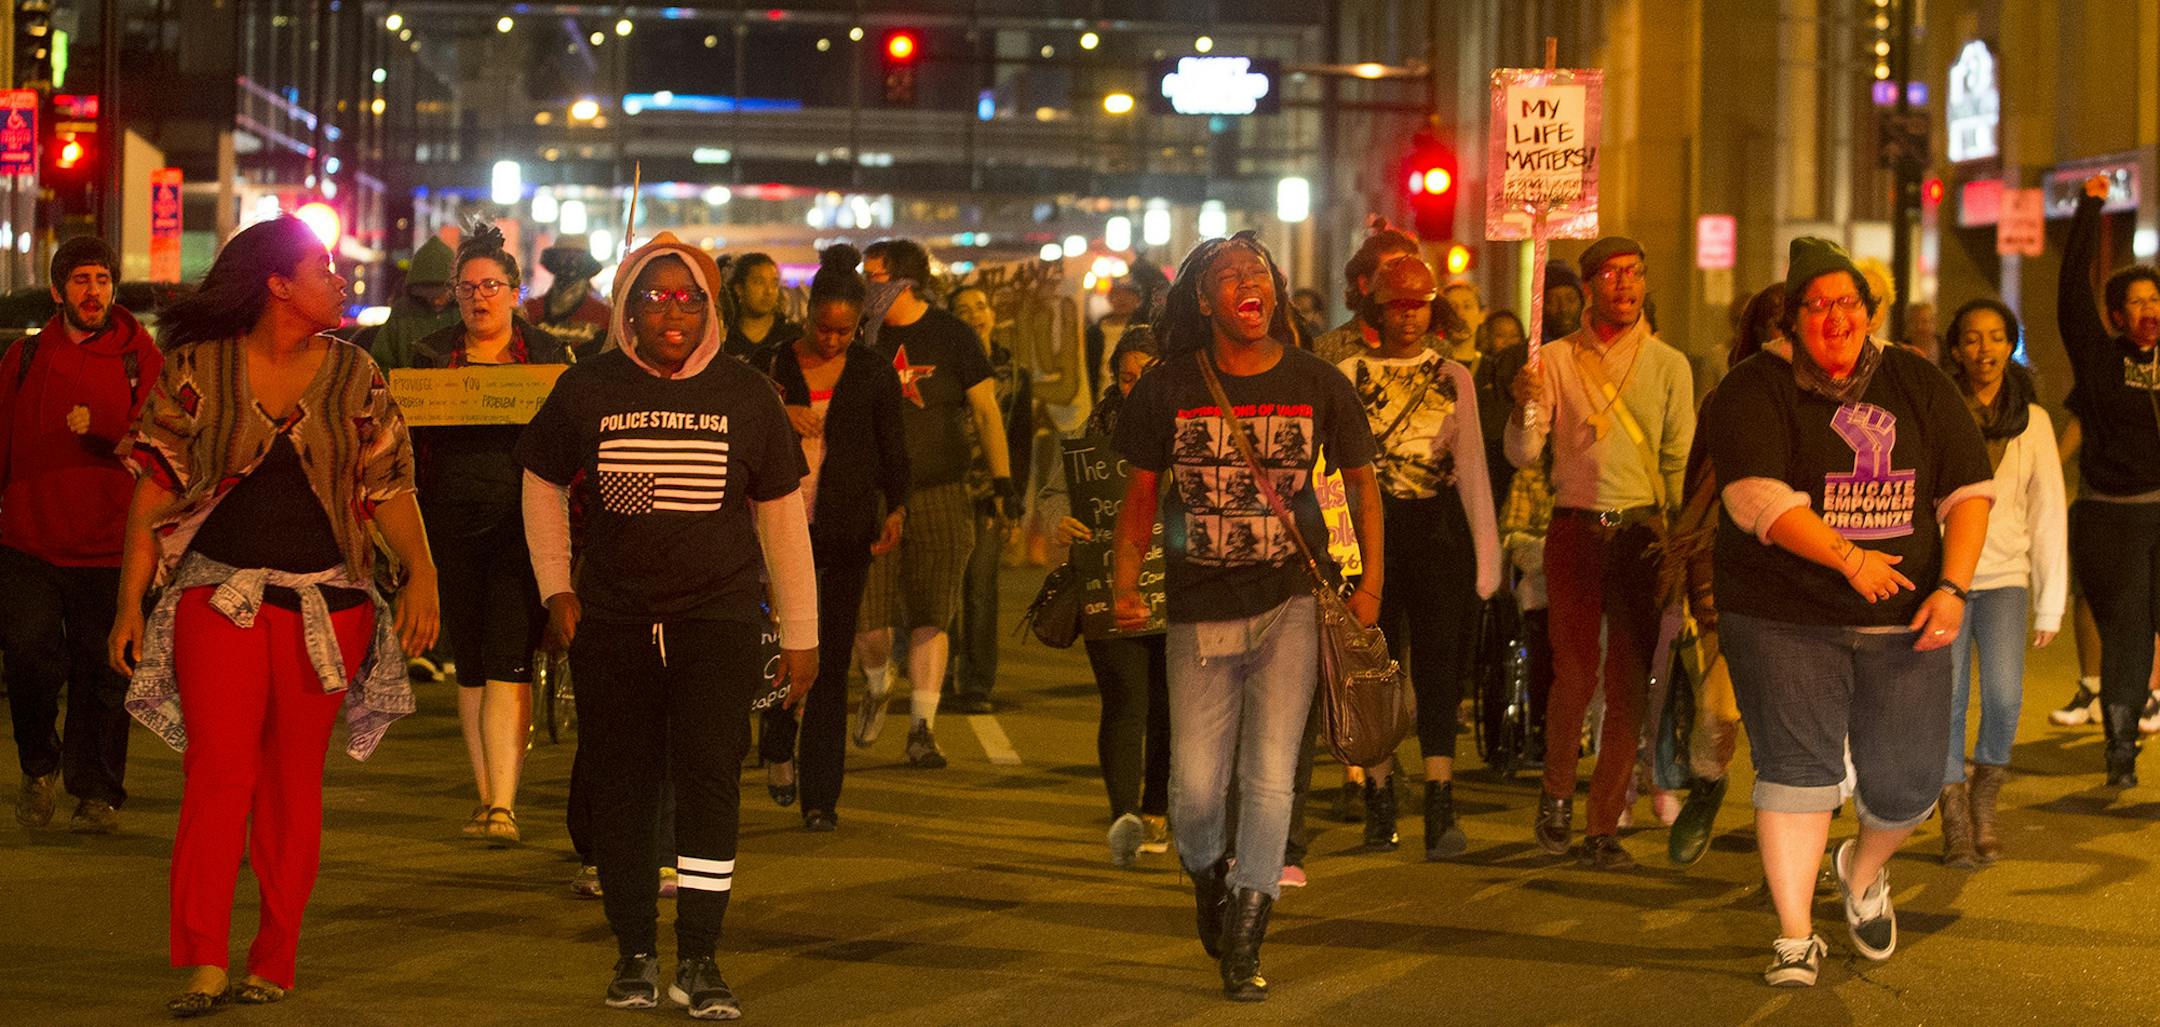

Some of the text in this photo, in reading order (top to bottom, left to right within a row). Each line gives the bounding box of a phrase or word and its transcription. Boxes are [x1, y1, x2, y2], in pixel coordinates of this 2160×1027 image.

[1521, 99, 1560, 120] MY
[1513, 122, 1574, 145] LIFE
[1505, 147, 1597, 171] MATTERS!
[463, 376, 481, 392] YOU
[1063, 447, 1110, 483] The
[1825, 480, 1916, 497] EDUCATE
[1824, 494, 1915, 512] EMPOWER
[1823, 510, 1914, 529] ORGANIZE
